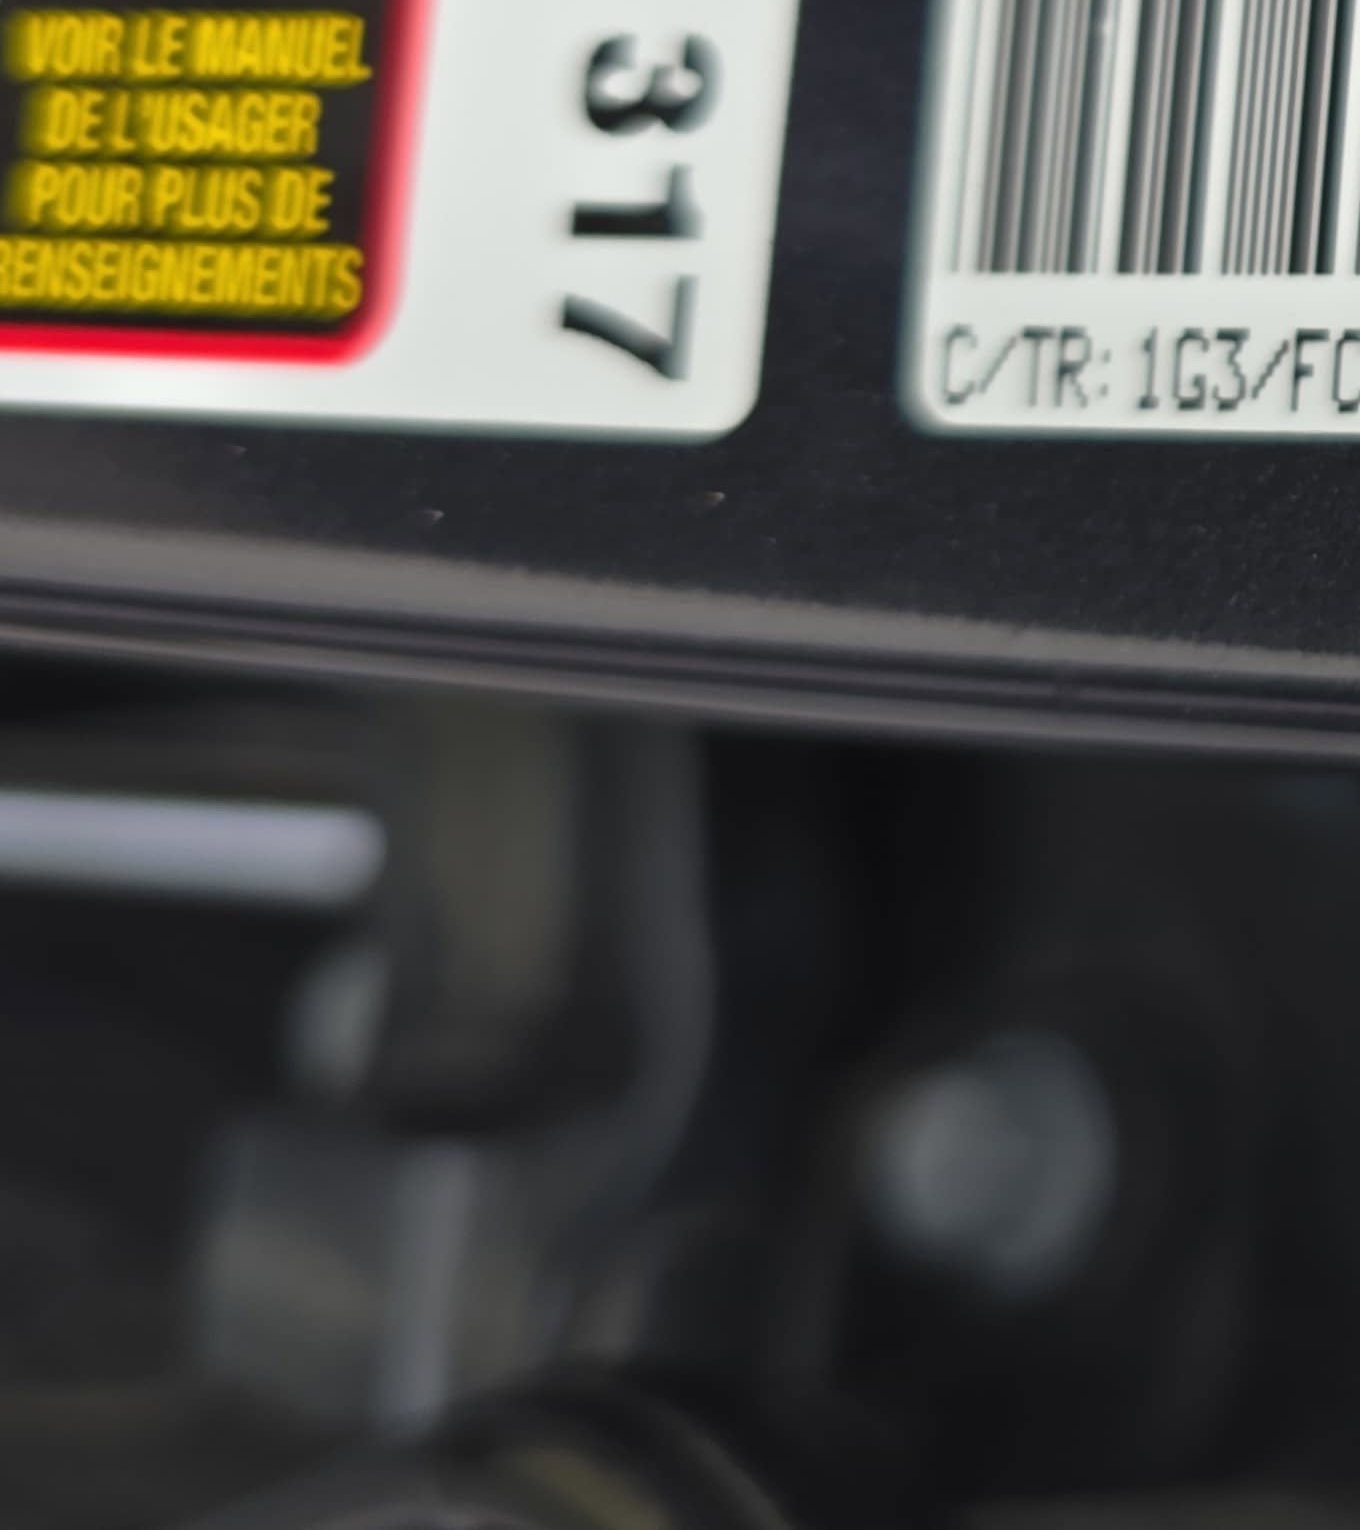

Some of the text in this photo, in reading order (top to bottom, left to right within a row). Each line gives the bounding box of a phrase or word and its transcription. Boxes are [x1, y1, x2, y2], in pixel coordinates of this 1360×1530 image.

[22, 10, 371, 86] VOIR LE MANUEL
[42, 89, 322, 156] DE L'USAGER
[25, 165, 334, 236] POUR PLUS DE
[562, 33, 724, 382] 317
